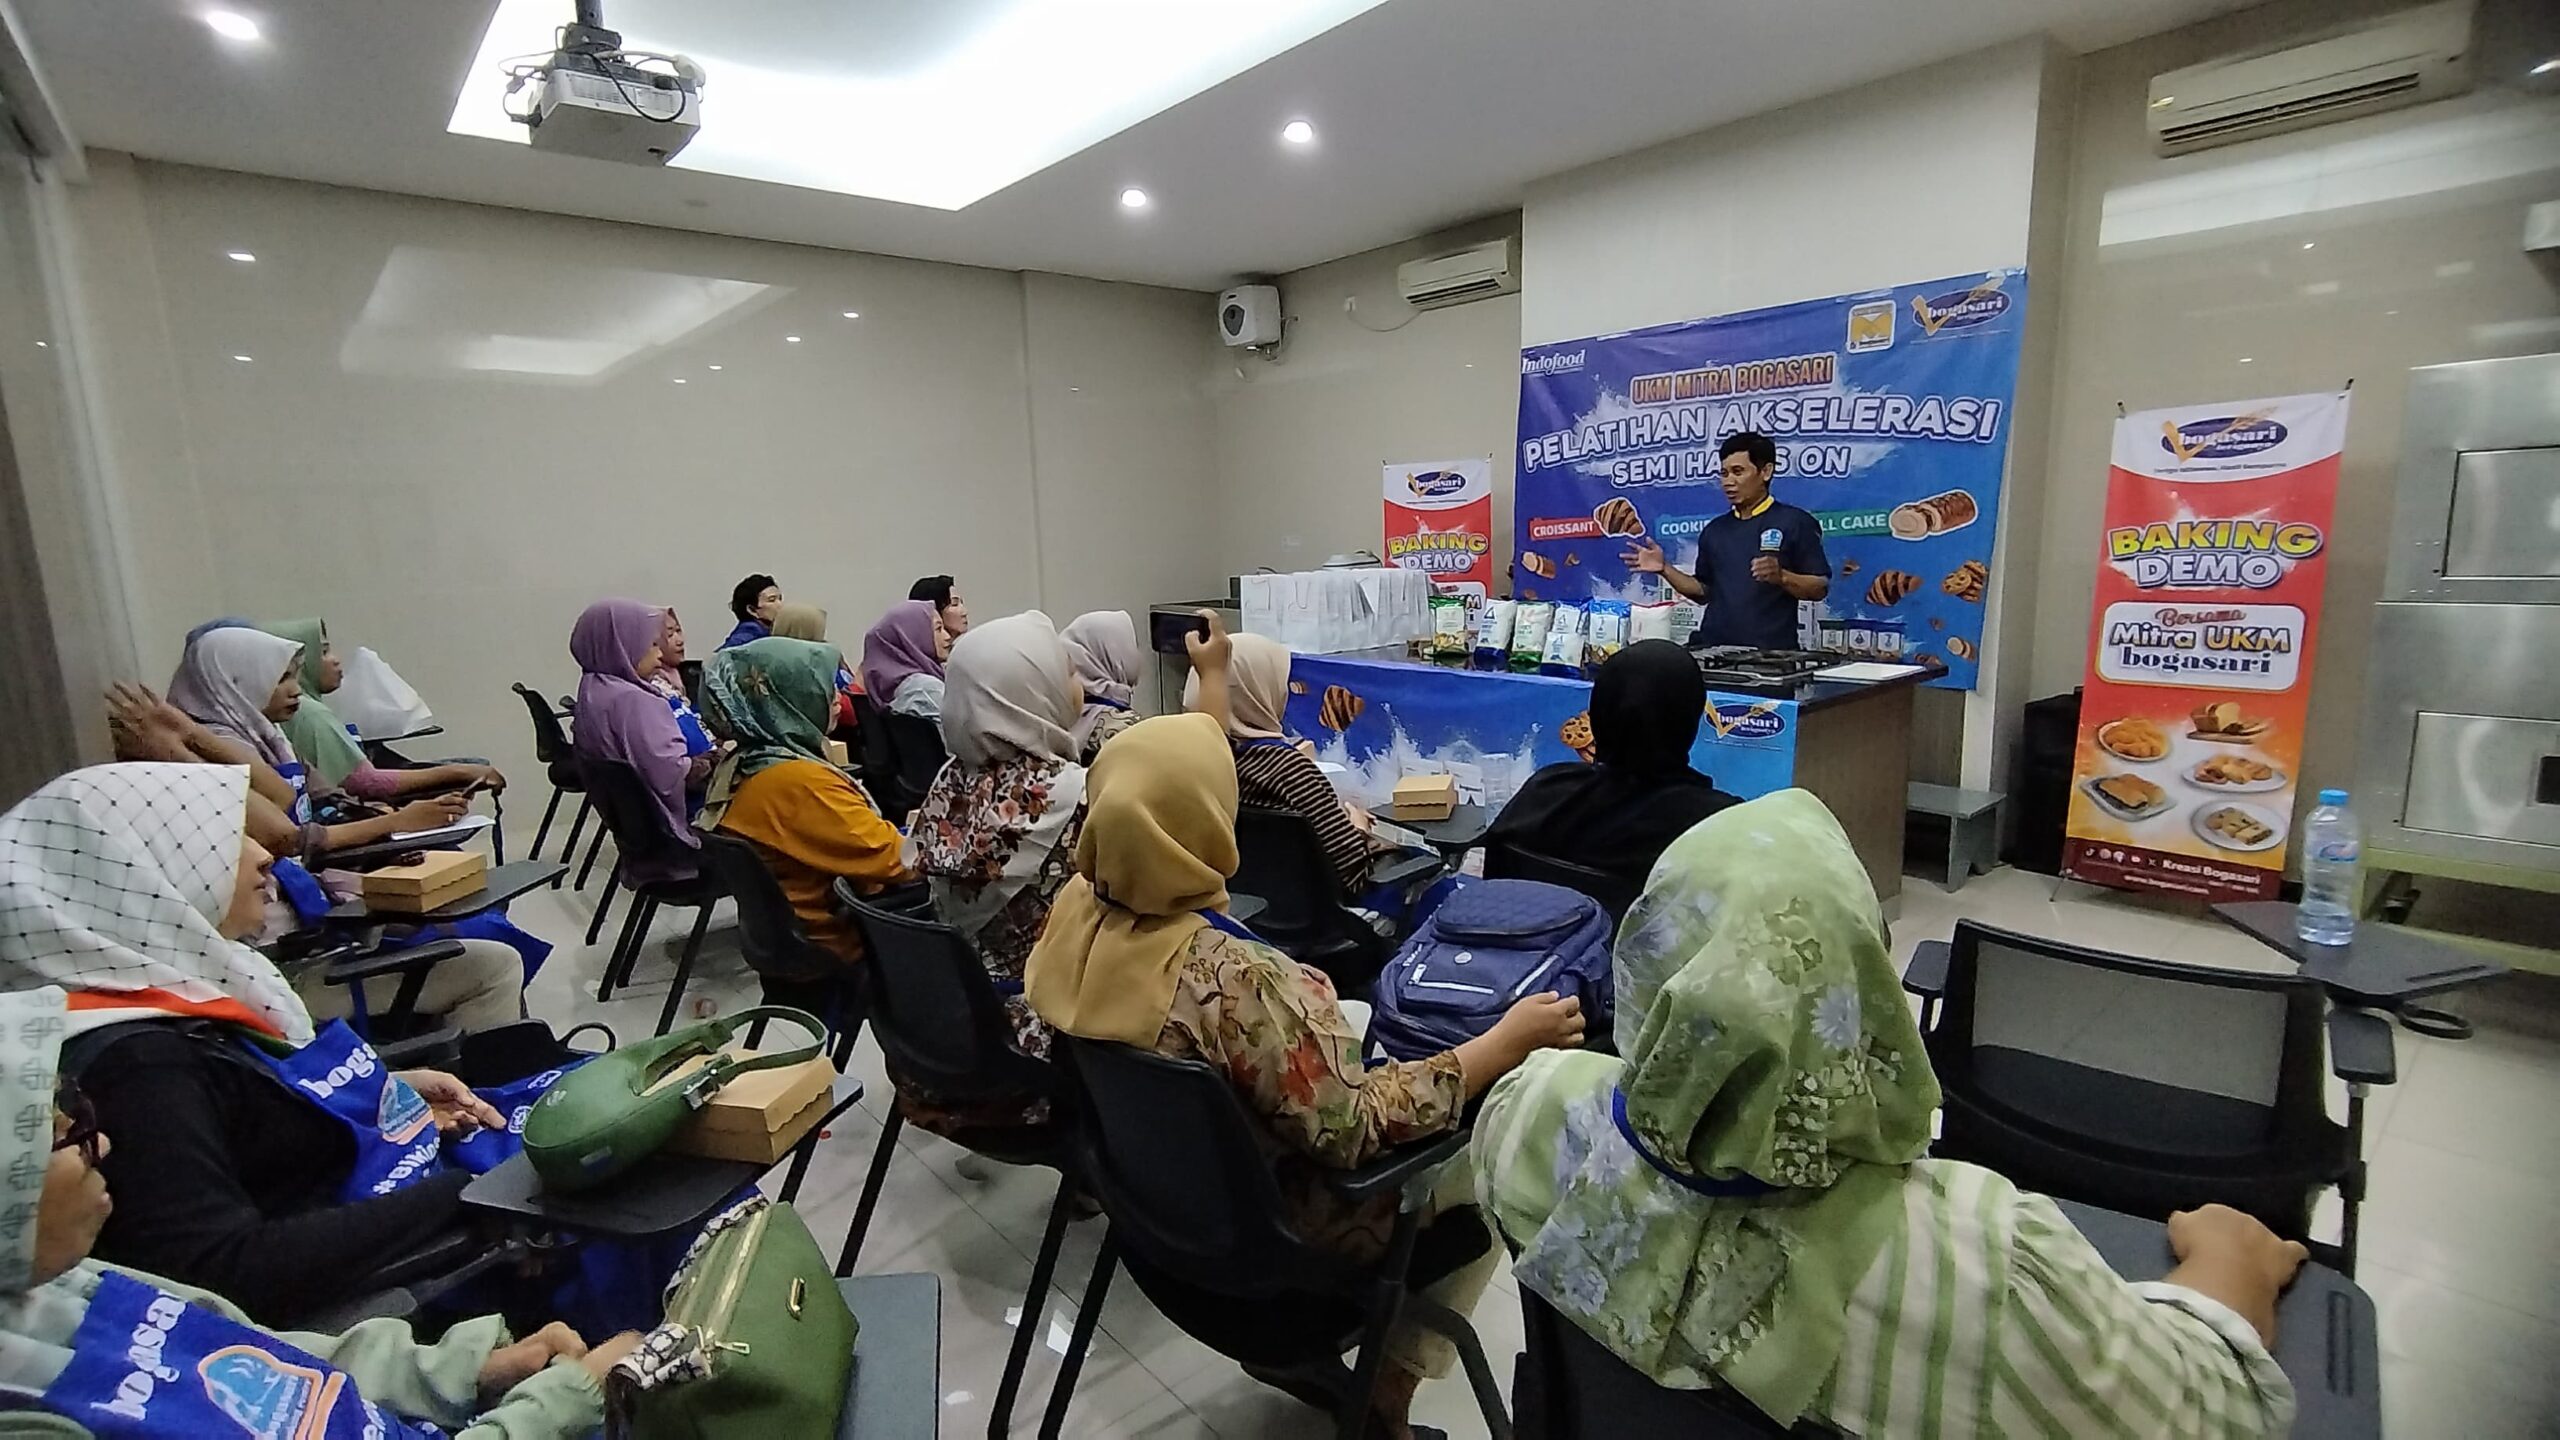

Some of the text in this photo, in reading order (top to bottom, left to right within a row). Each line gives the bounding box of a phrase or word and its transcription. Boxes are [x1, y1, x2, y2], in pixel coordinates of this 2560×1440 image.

[1522, 349, 1586, 375] Indofood
[1633, 356, 1834, 404] UKM MITRA BOGASARI
[1524, 396, 2001, 470] PELATIHAN AKSELERASI
[2177, 426, 2278, 446] bogasari
[1613, 446, 1849, 485] SEMI HAS ON
[1533, 520, 1595, 537] CROISSANT
[1660, 519, 1711, 535] COOKI
[1818, 513, 1887, 531] LL CAKE
[1388, 533, 1488, 556] BAKING
[2110, 520, 2321, 558] BAKING
[1404, 551, 1473, 572] DEMO
[2136, 552, 2281, 586] DEMO
[2154, 607, 2247, 627] Bersama
[2109, 622, 2291, 652] Mitra UKM
[2122, 646, 2272, 674] bogasari
[2161, 859, 2261, 885] Kreasi Bogasari
